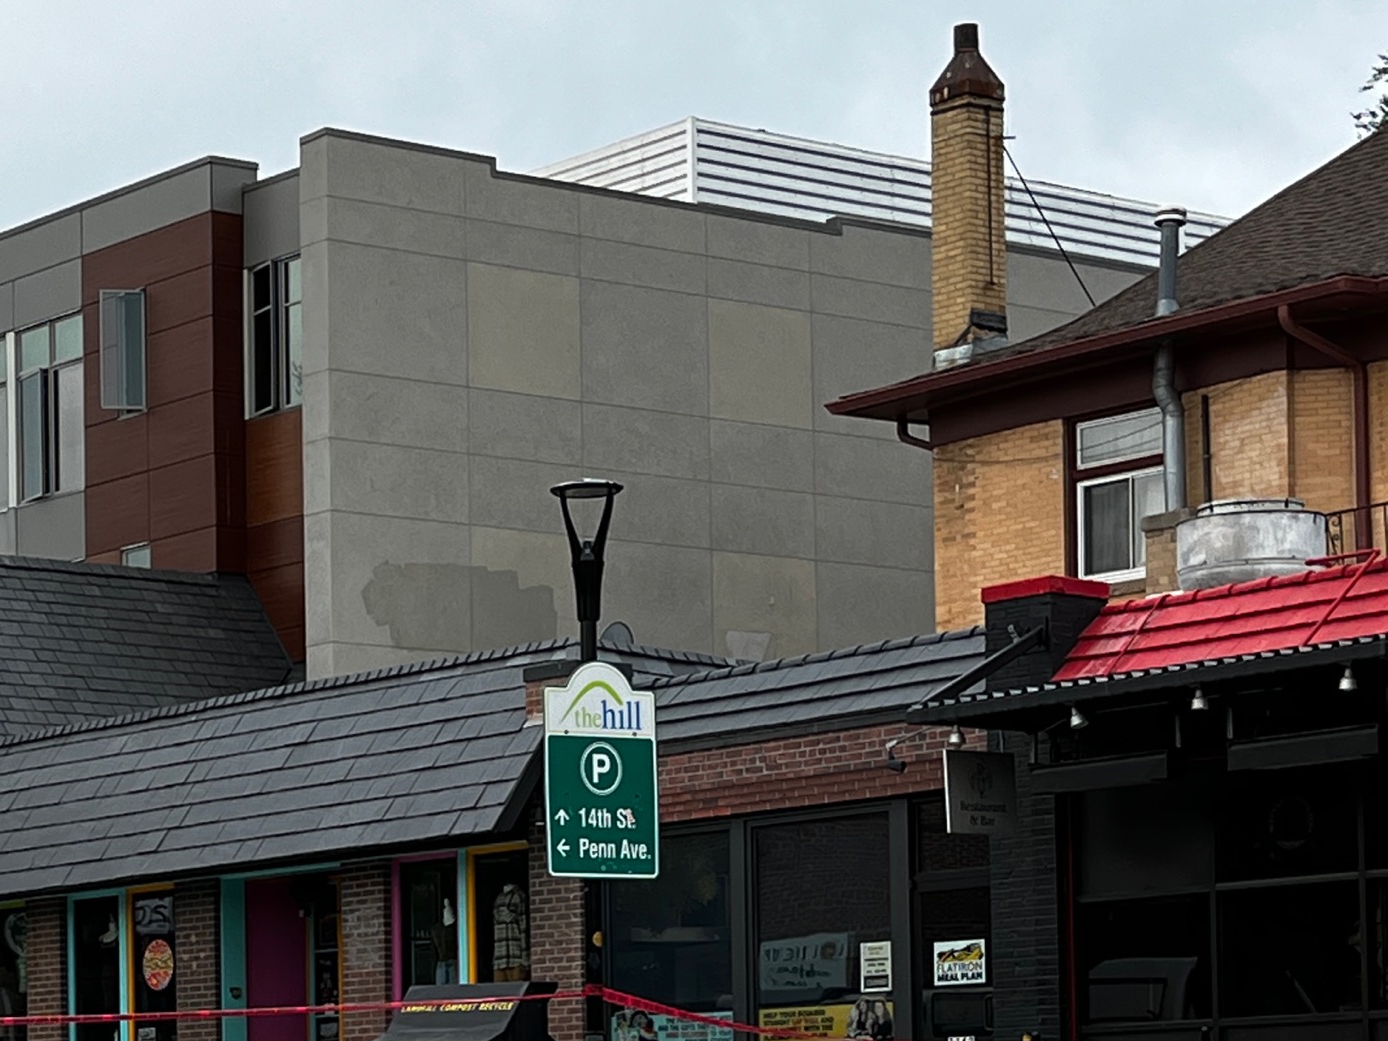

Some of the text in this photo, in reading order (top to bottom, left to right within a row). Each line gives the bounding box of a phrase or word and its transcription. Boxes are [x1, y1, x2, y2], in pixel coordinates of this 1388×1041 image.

[591, 753, 611, 784] P
[578, 807, 612, 828] 14th
[579, 838, 652, 860] Penn Ave.
[937, 962, 983, 974] FLATIRON
[937, 972, 983, 982] MEAL PLAN
[439, 1003, 478, 1012] COMPOST
